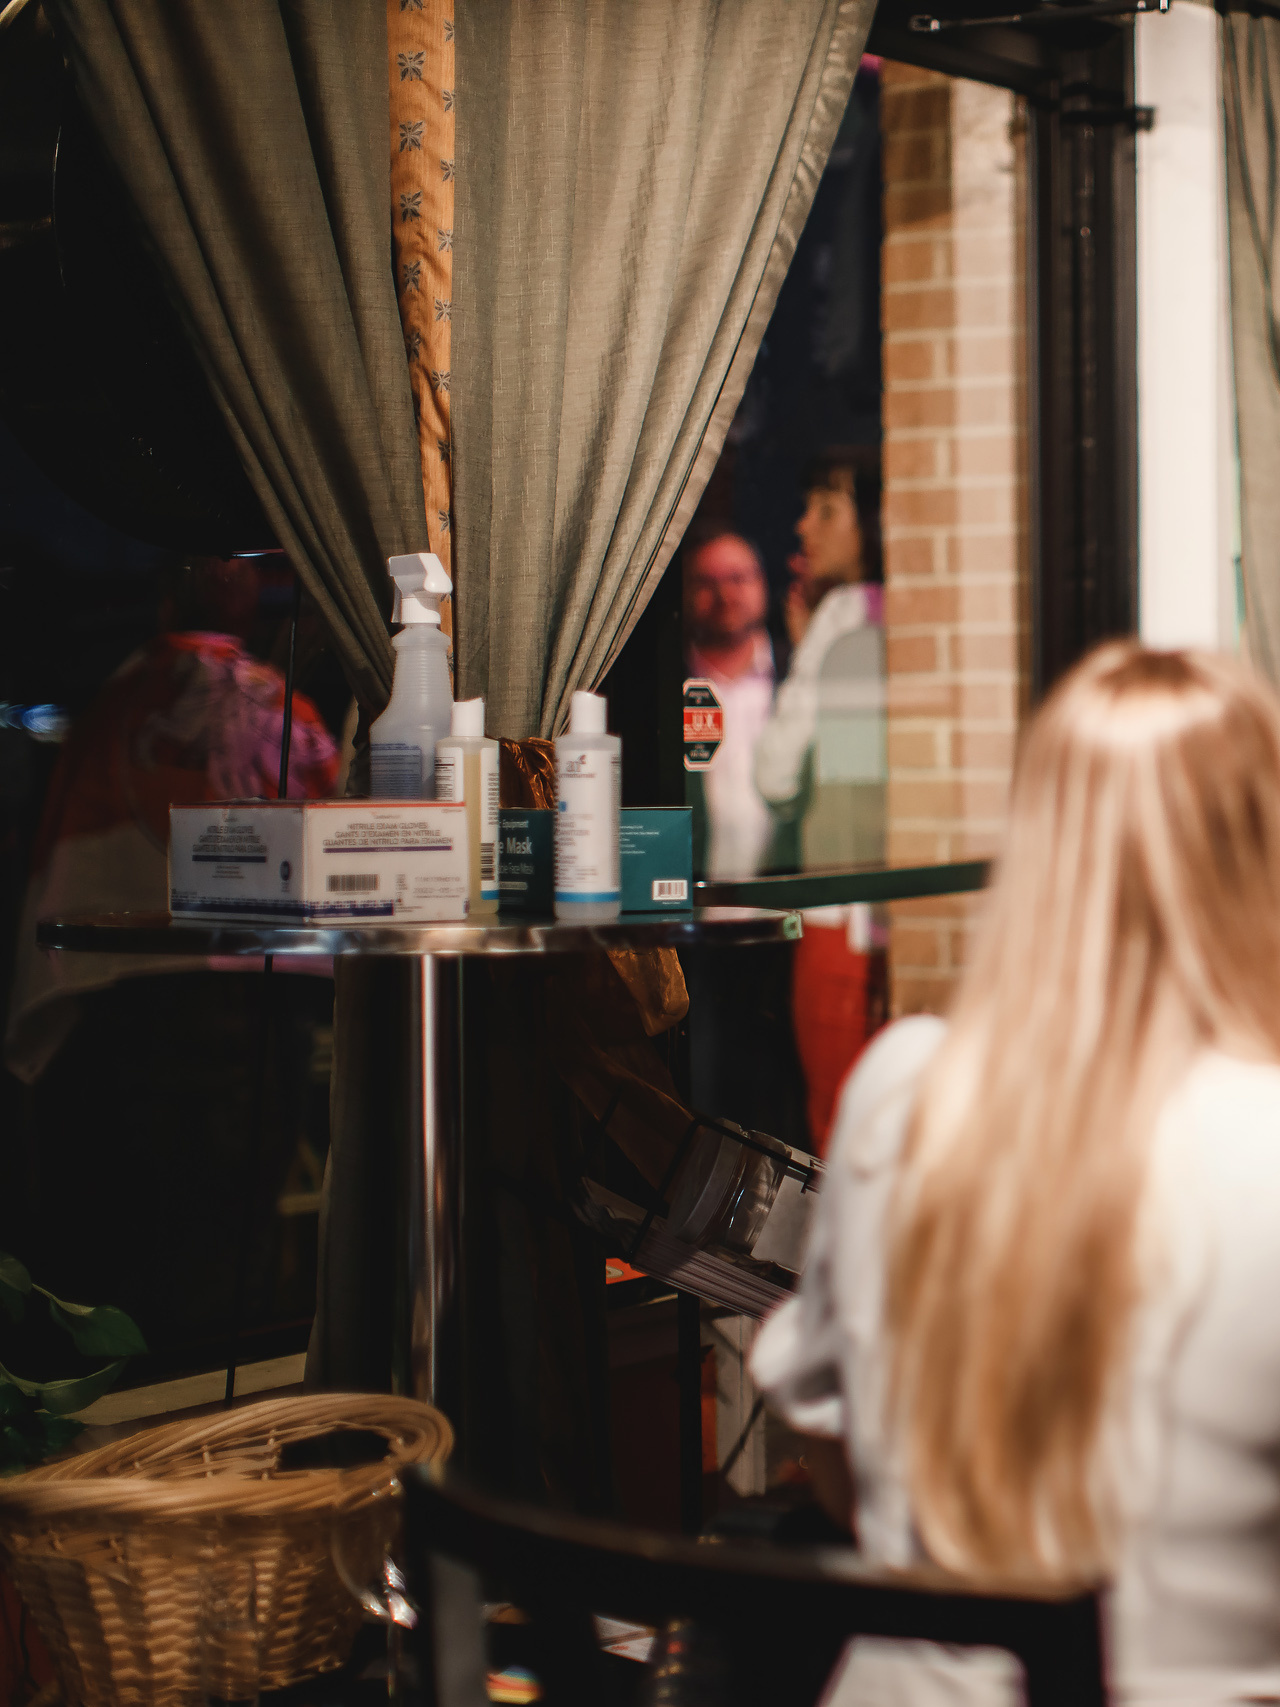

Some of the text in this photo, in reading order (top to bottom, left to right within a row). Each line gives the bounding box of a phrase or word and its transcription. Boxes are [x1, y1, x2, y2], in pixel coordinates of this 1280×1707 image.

[376, 822, 398, 830] EXAM
[399, 821, 428, 830] GLOVES
[502, 819, 529, 830] Equipment
[413, 829, 441, 837] NITRILE
[358, 838, 369, 846] DE
[506, 836, 533, 854] Mask
